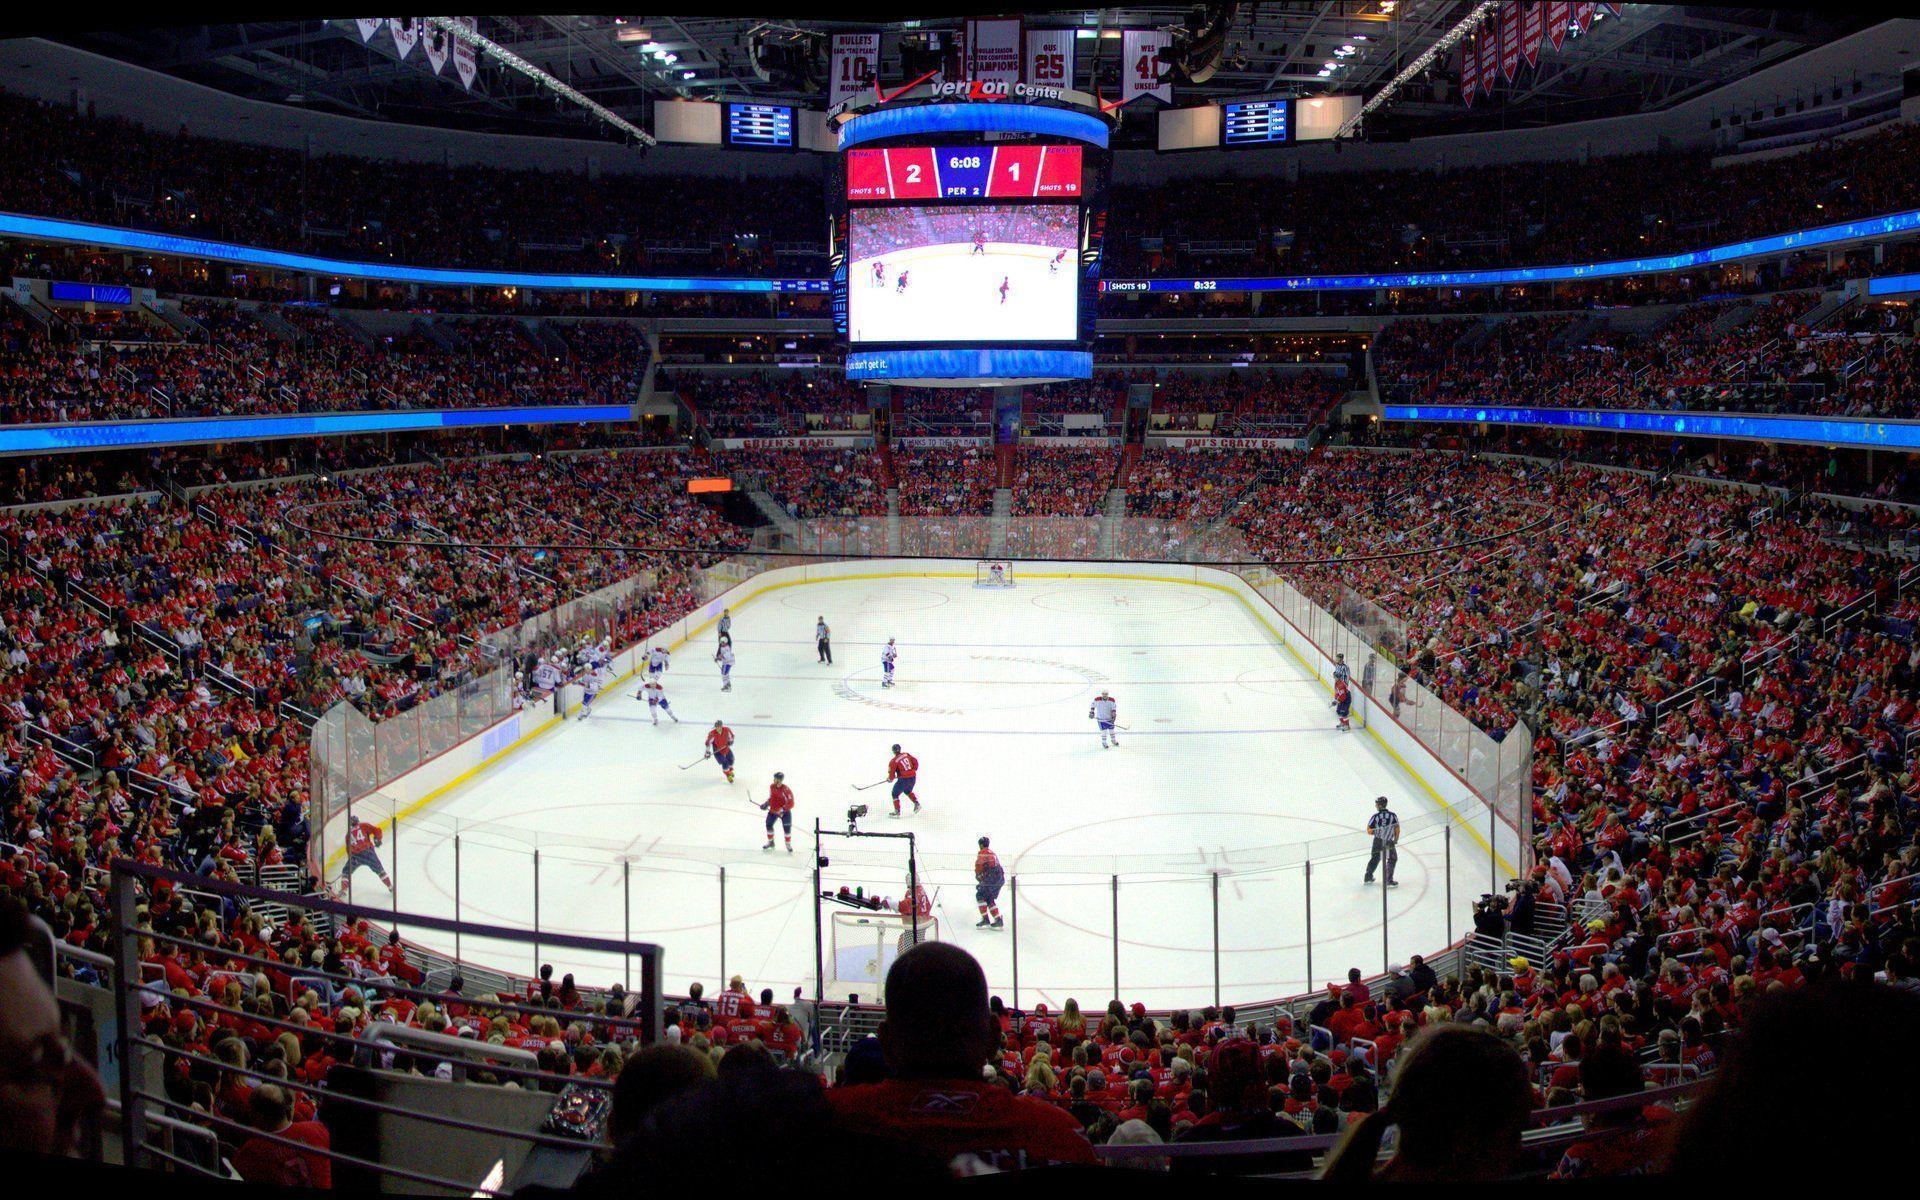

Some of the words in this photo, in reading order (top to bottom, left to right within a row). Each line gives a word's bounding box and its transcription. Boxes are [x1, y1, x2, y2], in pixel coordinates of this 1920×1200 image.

[840, 36, 872, 45] BULLETS
[842, 57, 867, 81] 10
[1035, 54, 1064, 79] 25
[1136, 55, 1159, 79] 41
[931, 78, 1009, 98] verizon
[1015, 83, 1064, 99] Center
[950, 156, 980, 168] 6:08
[905, 164, 921, 183] 2
[1008, 162, 1020, 182] 1
[1194, 281, 1216, 290] 8:32
[868, 361, 878, 371] get
[880, 360, 888, 369] it.
[1221, 439, 1258, 448] CRAZY
